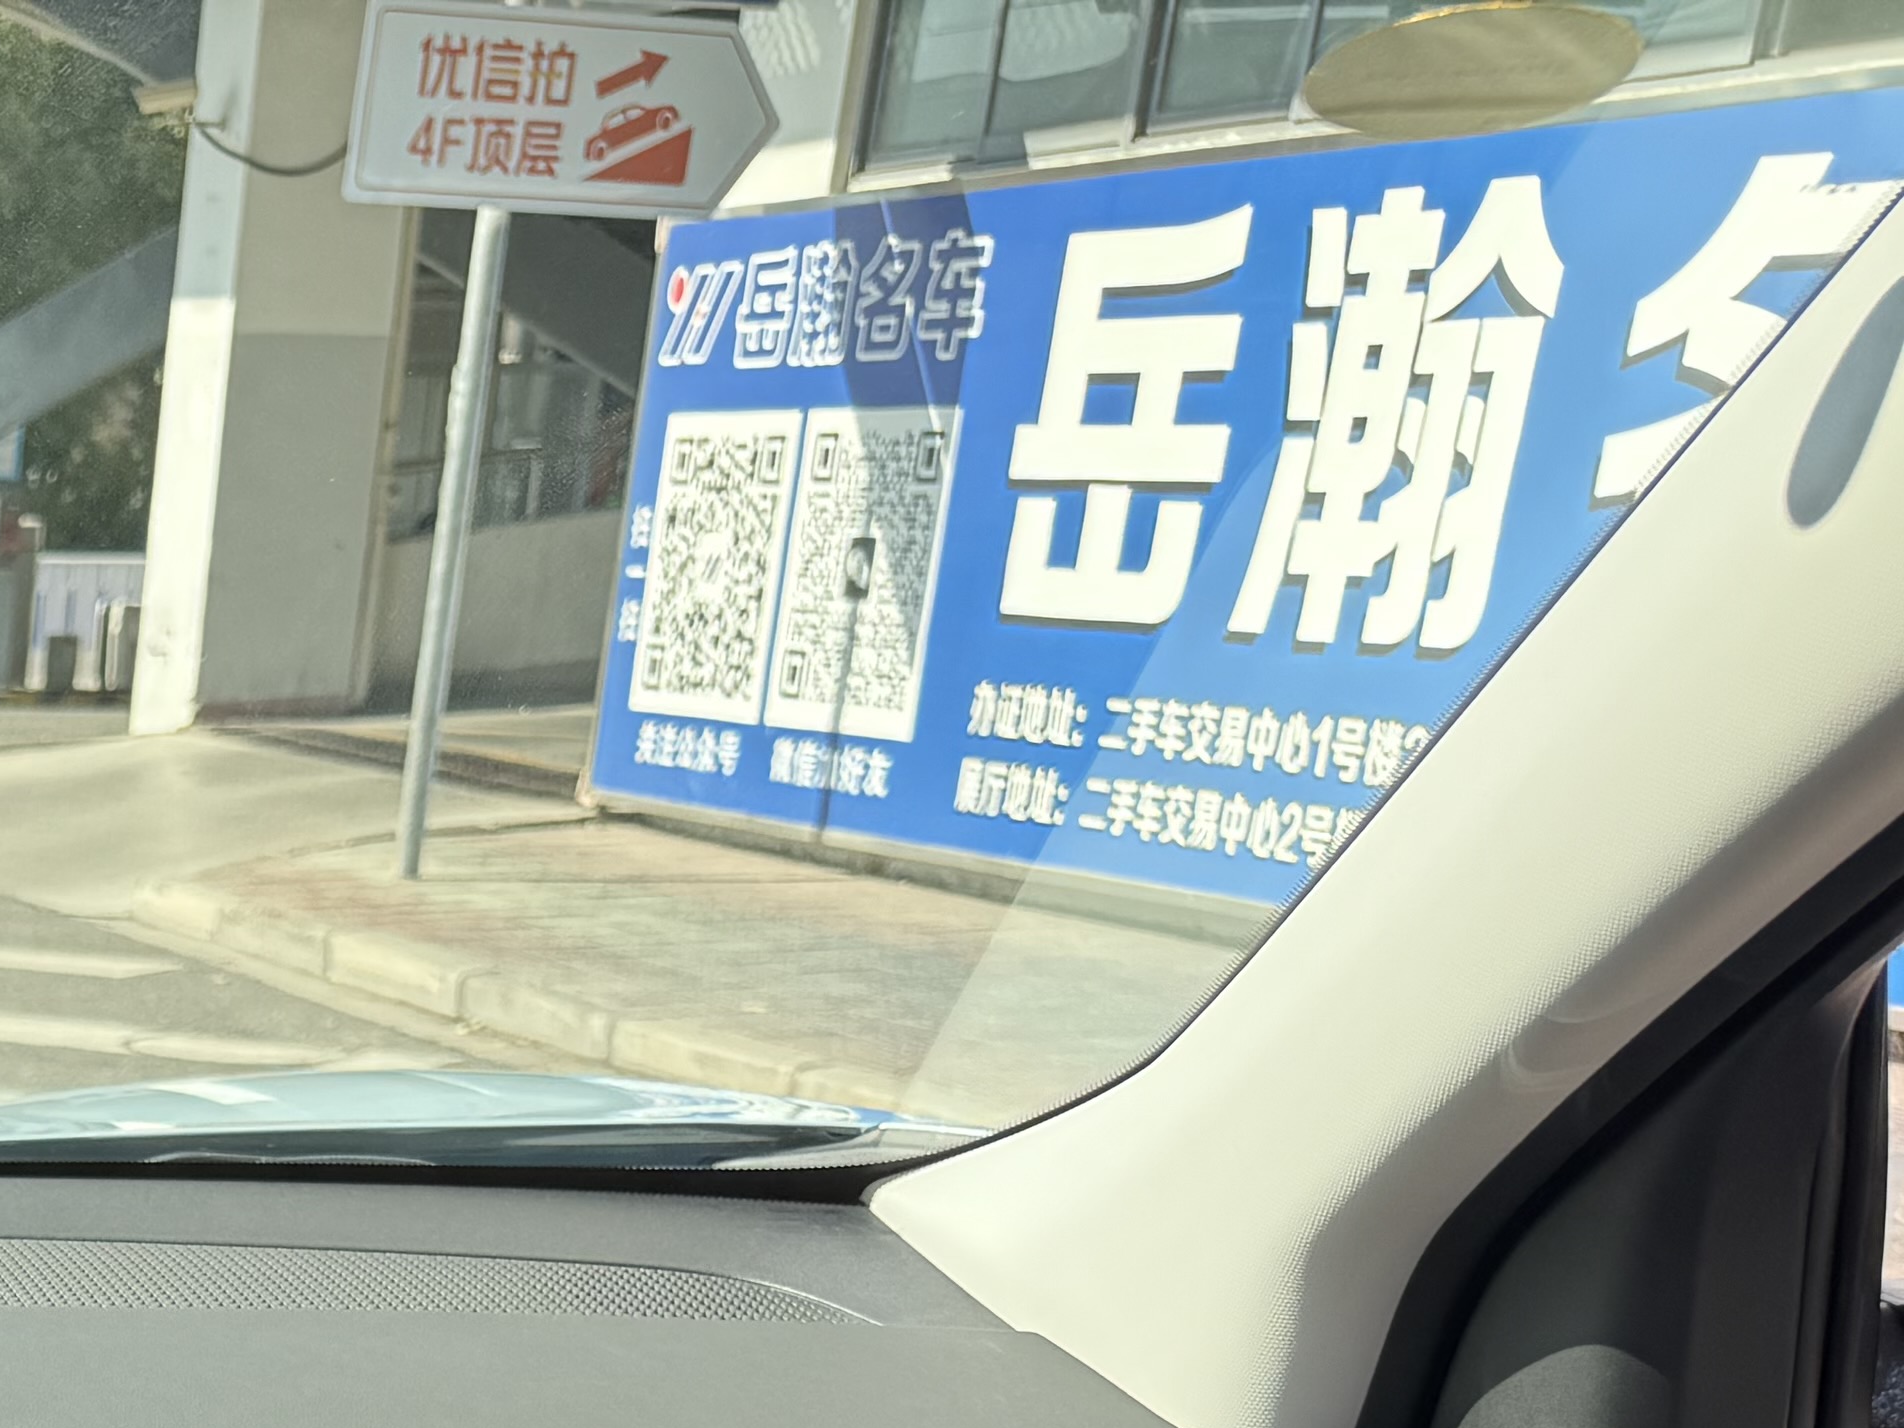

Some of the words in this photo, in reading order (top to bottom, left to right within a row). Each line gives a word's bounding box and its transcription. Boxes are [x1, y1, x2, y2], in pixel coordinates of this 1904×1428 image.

[416, 33, 577, 107] 优信拍
[407, 116, 564, 179] 4F顶层
